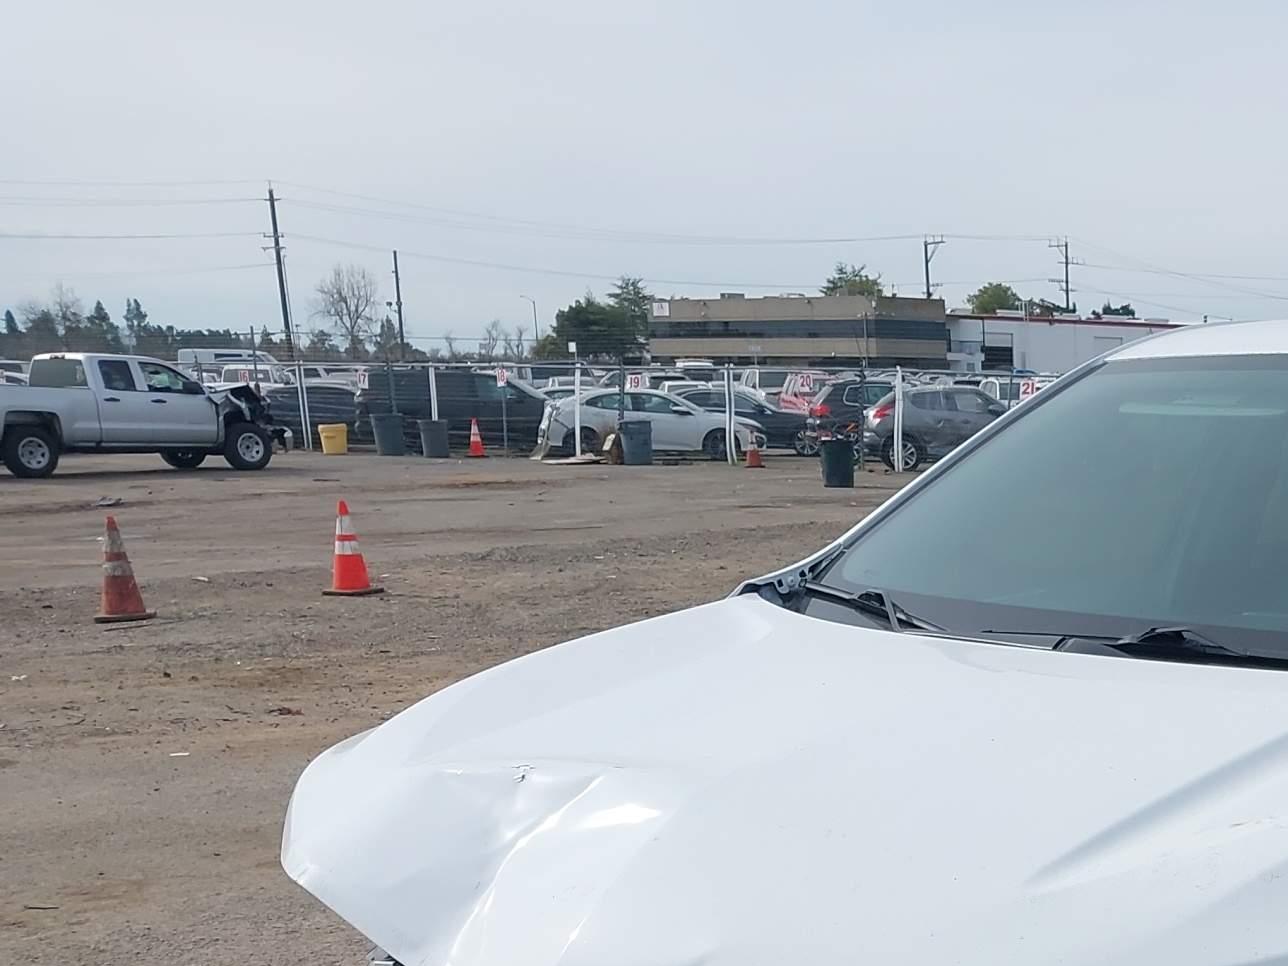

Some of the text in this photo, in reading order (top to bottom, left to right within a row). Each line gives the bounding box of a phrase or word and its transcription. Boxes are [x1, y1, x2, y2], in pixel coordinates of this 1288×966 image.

[497, 369, 505, 382] 18
[800, 374, 811, 387] 20
[629, 376, 640, 389] 19
[1021, 381, 1035, 395] 21
